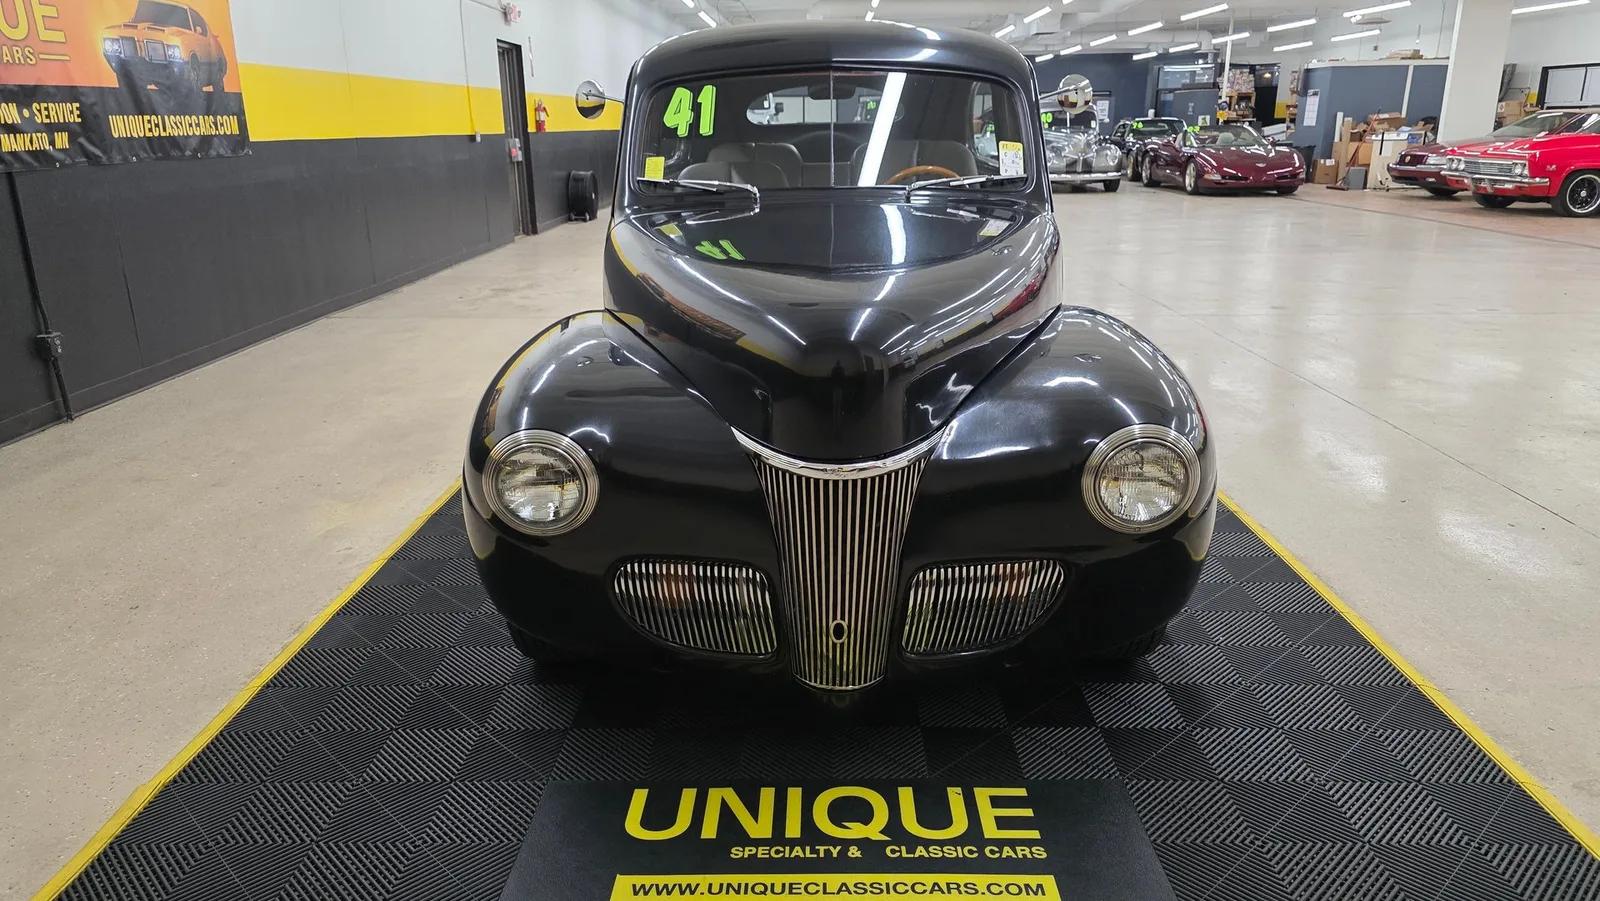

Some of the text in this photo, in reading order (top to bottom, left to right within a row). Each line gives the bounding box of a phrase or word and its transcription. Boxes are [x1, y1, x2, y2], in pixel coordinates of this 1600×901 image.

[32, 102, 81, 124] SERVICE
[663, 84, 716, 137] 41
[108, 114, 240, 138] UNIQUECLASSICCARS.COM
[54, 131, 69, 150] MN
[624, 785, 1042, 841] UNIQUE
[729, 845, 1048, 859] SPECIALTY & CLASSIC CARS
[631, 880, 1047, 897] WWW.UNIQUECLASSICCARS.COM
